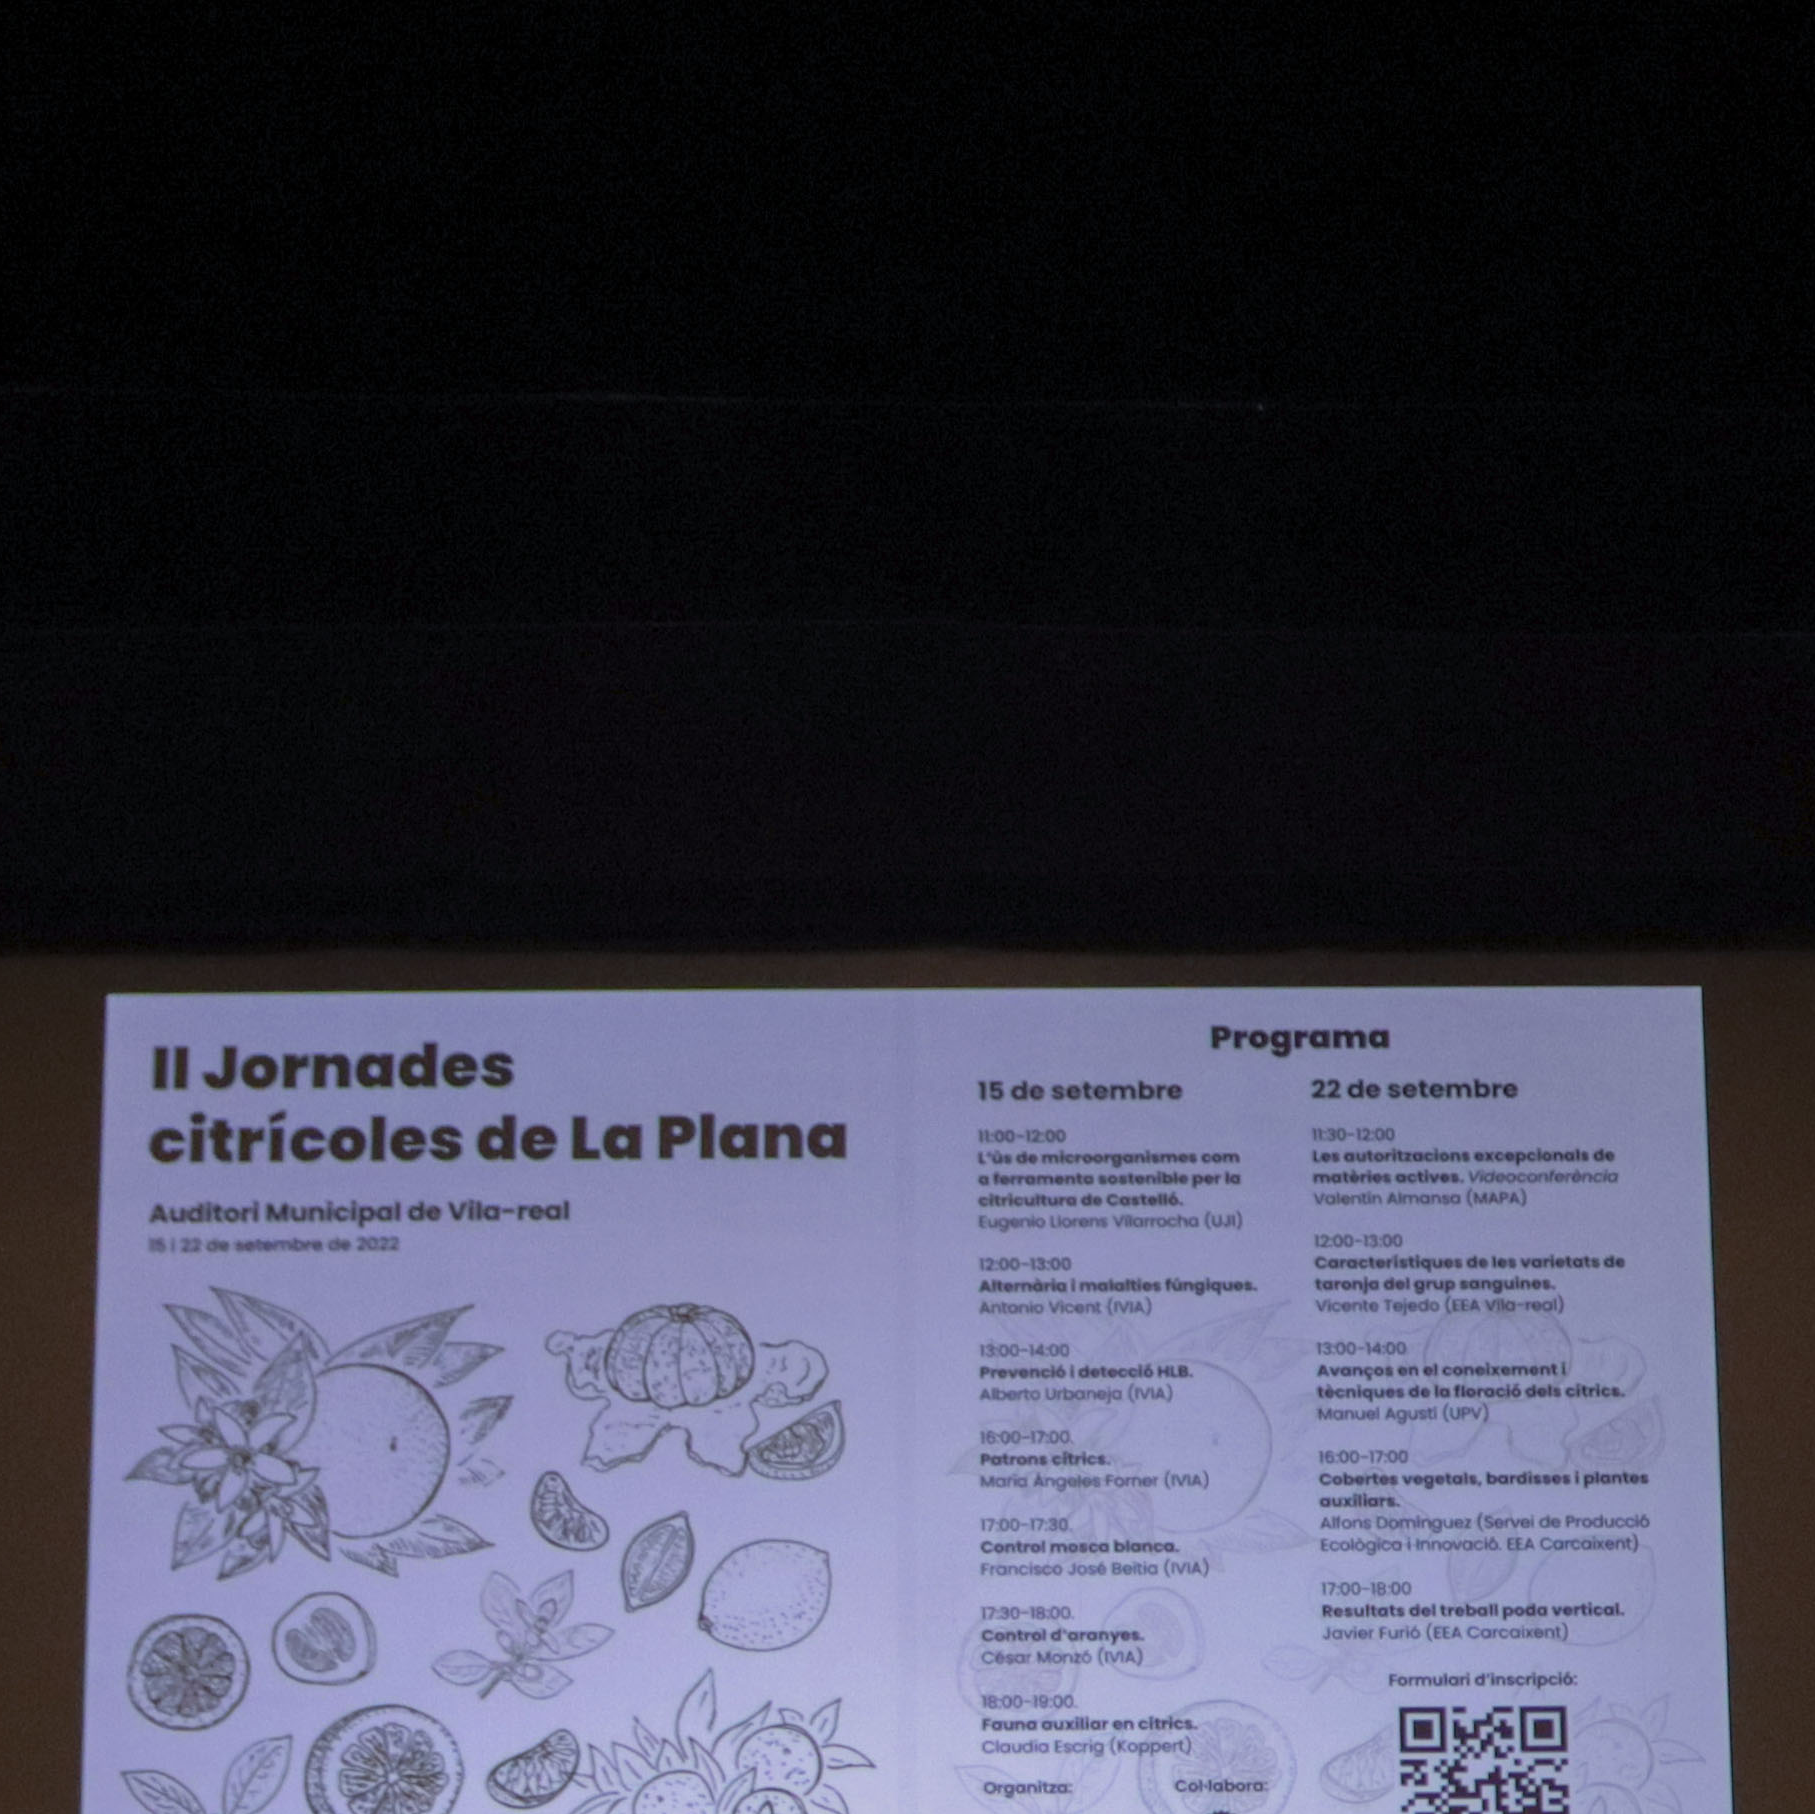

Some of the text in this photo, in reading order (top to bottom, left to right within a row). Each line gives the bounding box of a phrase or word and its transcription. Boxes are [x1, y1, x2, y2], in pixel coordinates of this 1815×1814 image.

[1210, 1025, 1391, 1058] Programa
[152, 1041, 515, 1091] II Jornades
[977, 1080, 1183, 1101] 15 de setembre
[1311, 1078, 1519, 1099] 22 de setembre
[148, 1110, 847, 1164] citrícoles de La Plana
[1040, 1149, 1241, 1169] microorganismes com
[1342, 1147, 1590, 1167] autoritzacions excepcionals
[992, 1170, 1222, 1189] ferramenta sostenible per
[1394, 1168, 1465, 1185] actives.
[1468, 1169, 1619, 1185] Videoconferència
[977, 1191, 1184, 1208] citricultura Castelló.
[1386, 1188, 1528, 1208] Almansa (MAPA)
[148, 1199, 571, 1229] Auditori Municipal de Vila-real
[977, 1210, 1244, 1234] Eugenio Vilarrocha (UJI)
[1519, 1254, 1601, 1269] varietats
[1078, 1277, 1162, 1293] malalties
[1164, 1277, 1258, 1297] fúngiques.
[1314, 1275, 1556, 1295] taronja grup sanguines.
[978, 1296, 1153, 1317] Antonio Vicent (IVIA)
[1315, 1294, 1565, 1317] Vicente Tejedo (EEA Vila-real)
[979, 1363, 1193, 1380] Prevenció detecció HLB.
[1316, 1361, 1559, 1382] Avanços coneixement
[979, 1382, 1174, 1405] Alberto Urbaneja (IVIA)
[1316, 1383, 1562, 1403] tècniques floració dels
[1315, 1402, 1490, 1425] Manuel (UPV)
[979, 1452, 1049, 1467] Patrons
[1103, 1473, 1159, 1489] Forner
[1163, 1469, 1210, 1490] (IVIA)
[1318, 1470, 1650, 1490] Cobertes vegetals, bardisses plantes
[1319, 1492, 1401, 1508] auxiliars.
[1475, 1511, 1651, 1533] (Servei Producció
[980, 1539, 1180, 1555] Control mosca blanca.
[1319, 1532, 1641, 1557] Ecològica Carcaixent)
[979, 1557, 1211, 1579] Francisco José (IVIA)
[1321, 1602, 1625, 1621] Resultats treball poda vertical.
[980, 1628, 1047, 1643] Control
[1322, 1621, 1569, 1643] Javier Furió (EEA Carcaixent)
[980, 1646, 1144, 1667] César Monzó (IVIA)
[1388, 1672, 1471, 1687] Formulari
[981, 1716, 1109, 1732] Fauna auxiliar
[981, 1735, 1192, 1760] Claudia Escrig (Koppert)
[982, 1780, 1073, 1800] Organitza:
